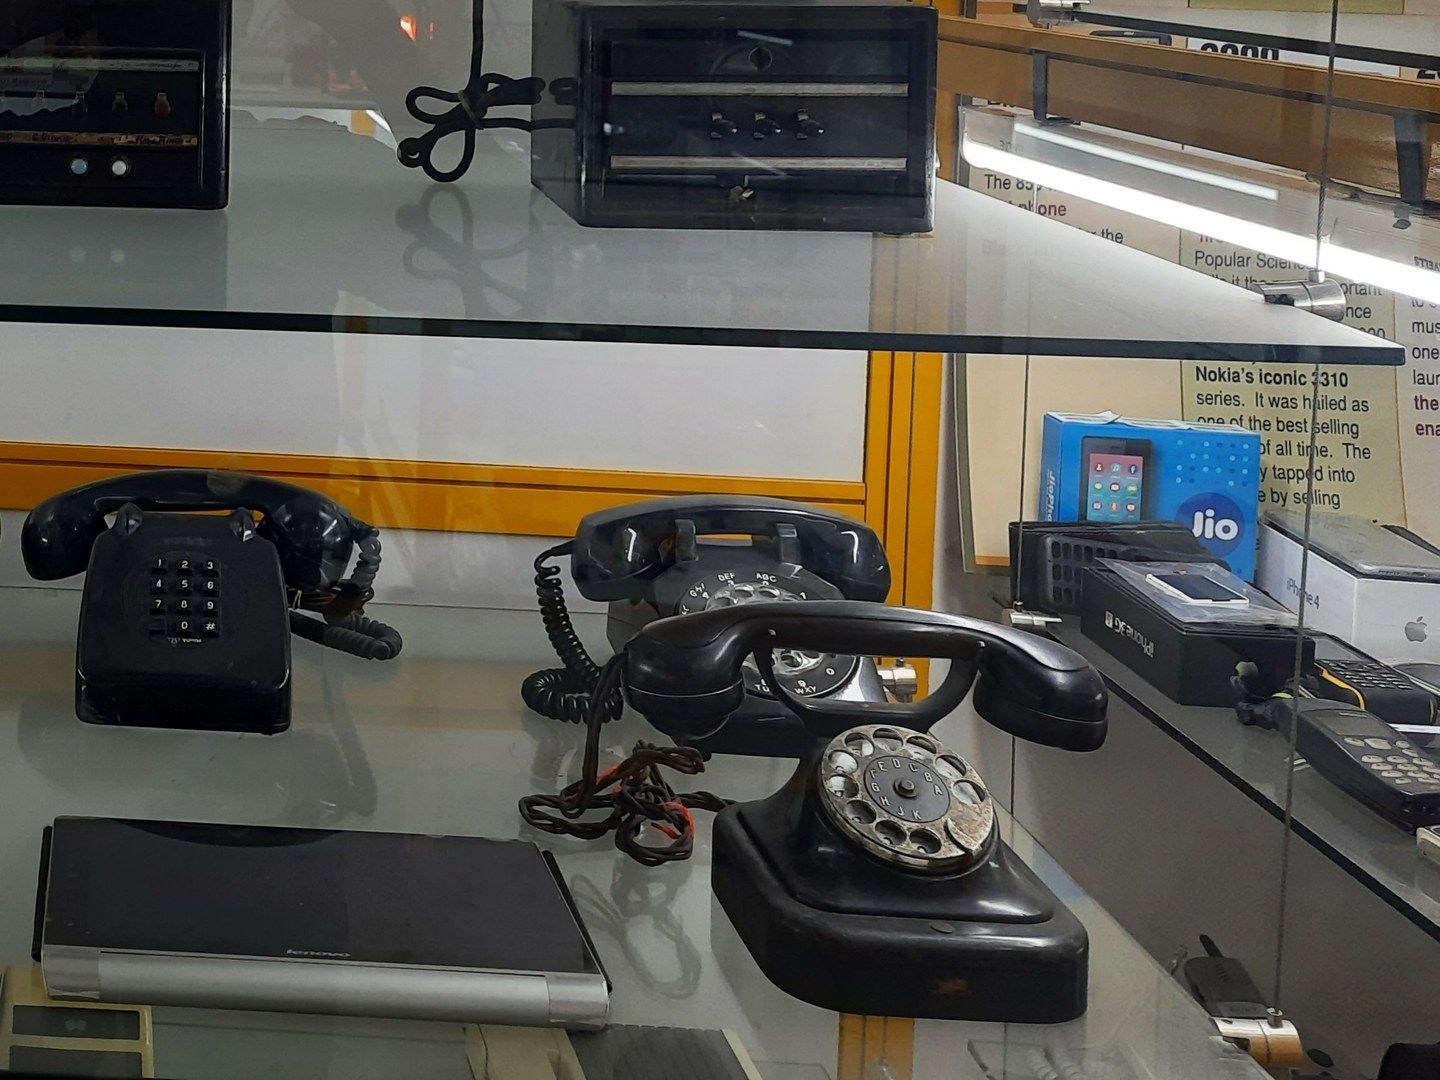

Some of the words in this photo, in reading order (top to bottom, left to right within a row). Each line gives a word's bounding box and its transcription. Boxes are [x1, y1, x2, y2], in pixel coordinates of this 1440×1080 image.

[985, 174, 1011, 190] The
[1195, 251, 1251, 270] Popular
[1196, 366, 1254, 383] Nokia's
[1259, 369, 1307, 385] iconic
[1197, 391, 1245, 407] series.
[1255, 392, 1264, 407] It
[1268, 395, 1298, 409] was
[1352, 399, 1369, 412] as
[1249, 417, 1271, 431] the
[1276, 417, 1308, 433] best
[1312, 420, 1359, 437] selling
[1276, 441, 1292, 455] all
[1343, 443, 1371, 459] The
[1328, 466, 1355, 482] into
[1271, 489, 1287, 505] by
[1192, 509, 1239, 540] Jio
[158, 559, 162, 568] 1
[181, 560, 188, 568] 2
[207, 561, 213, 569] 3
[156, 579, 161, 587] 4
[181, 580, 188, 588] 5
[207, 581, 213, 589] 6
[756, 573, 777, 582] ABC
[181, 621, 188, 629] 0
